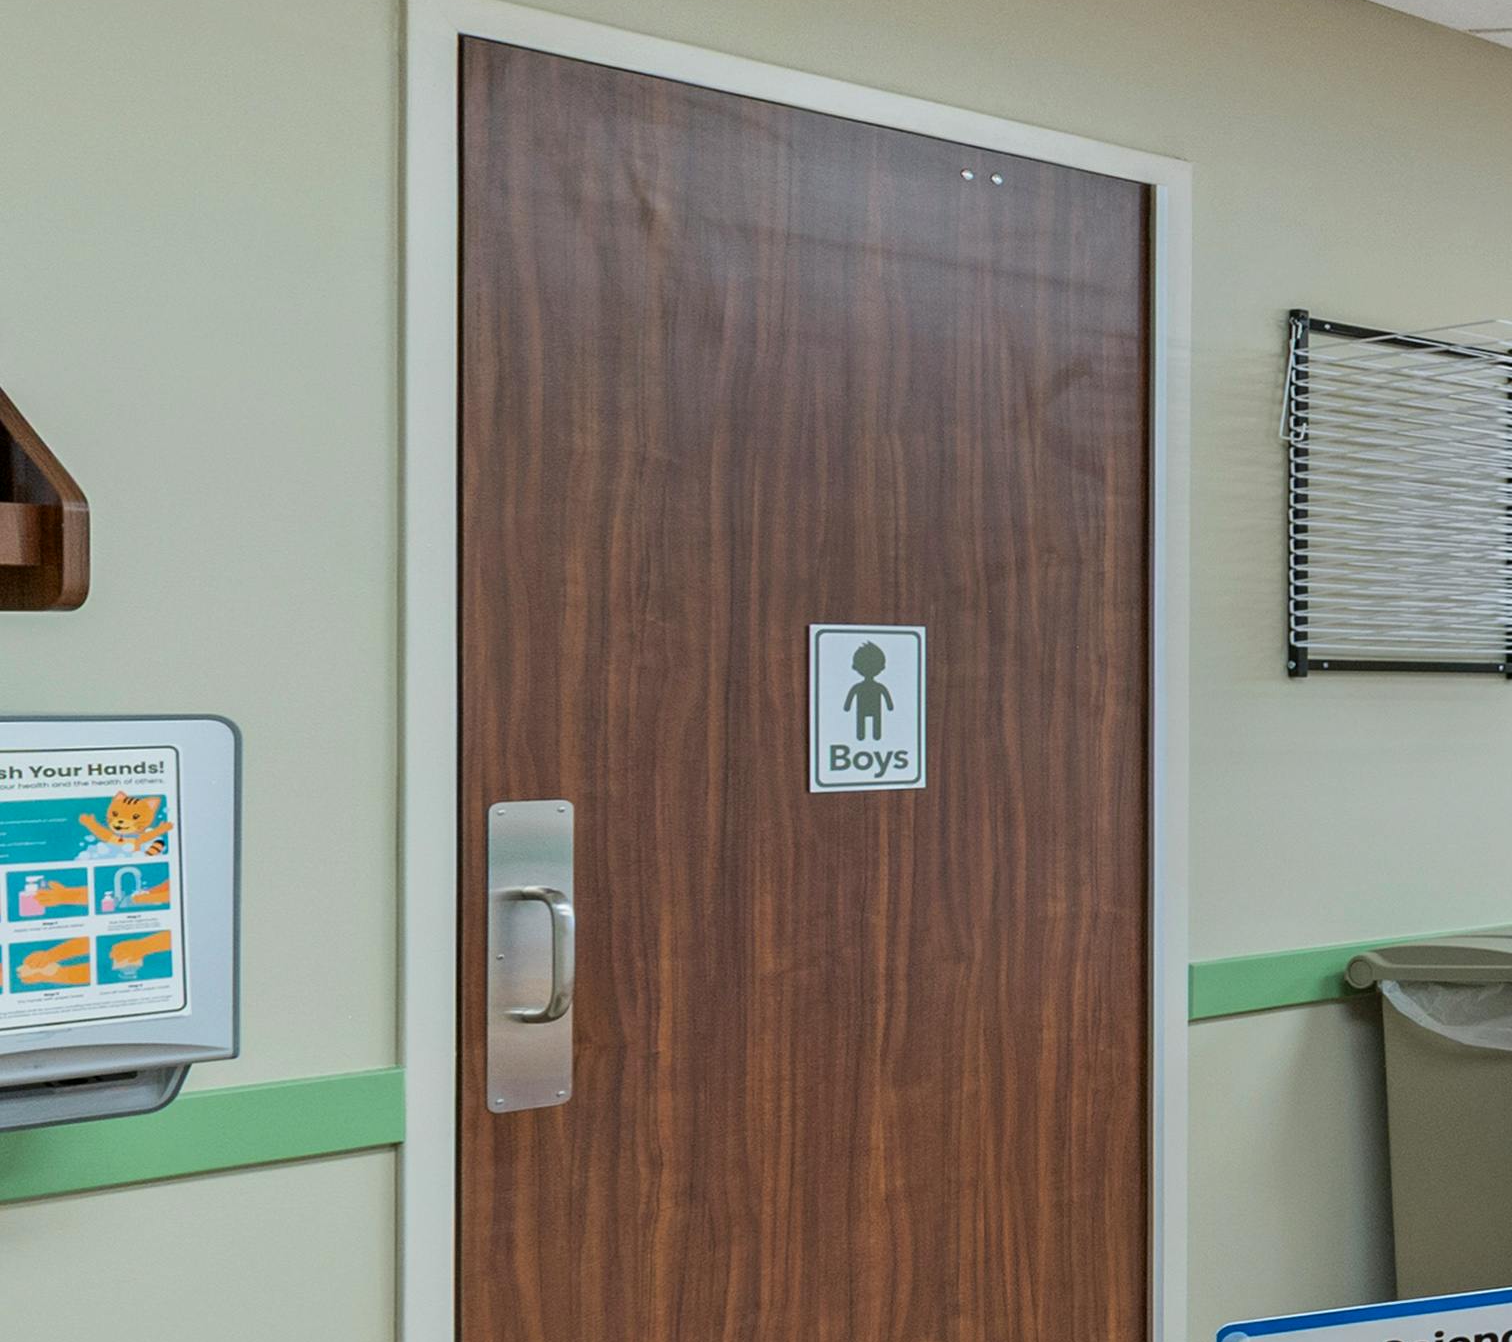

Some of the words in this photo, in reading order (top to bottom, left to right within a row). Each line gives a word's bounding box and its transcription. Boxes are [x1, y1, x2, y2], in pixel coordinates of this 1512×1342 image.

[29, 765, 83, 779] Your
[87, 761, 165, 777] Hands!
[829, 744, 909, 779] Boys
